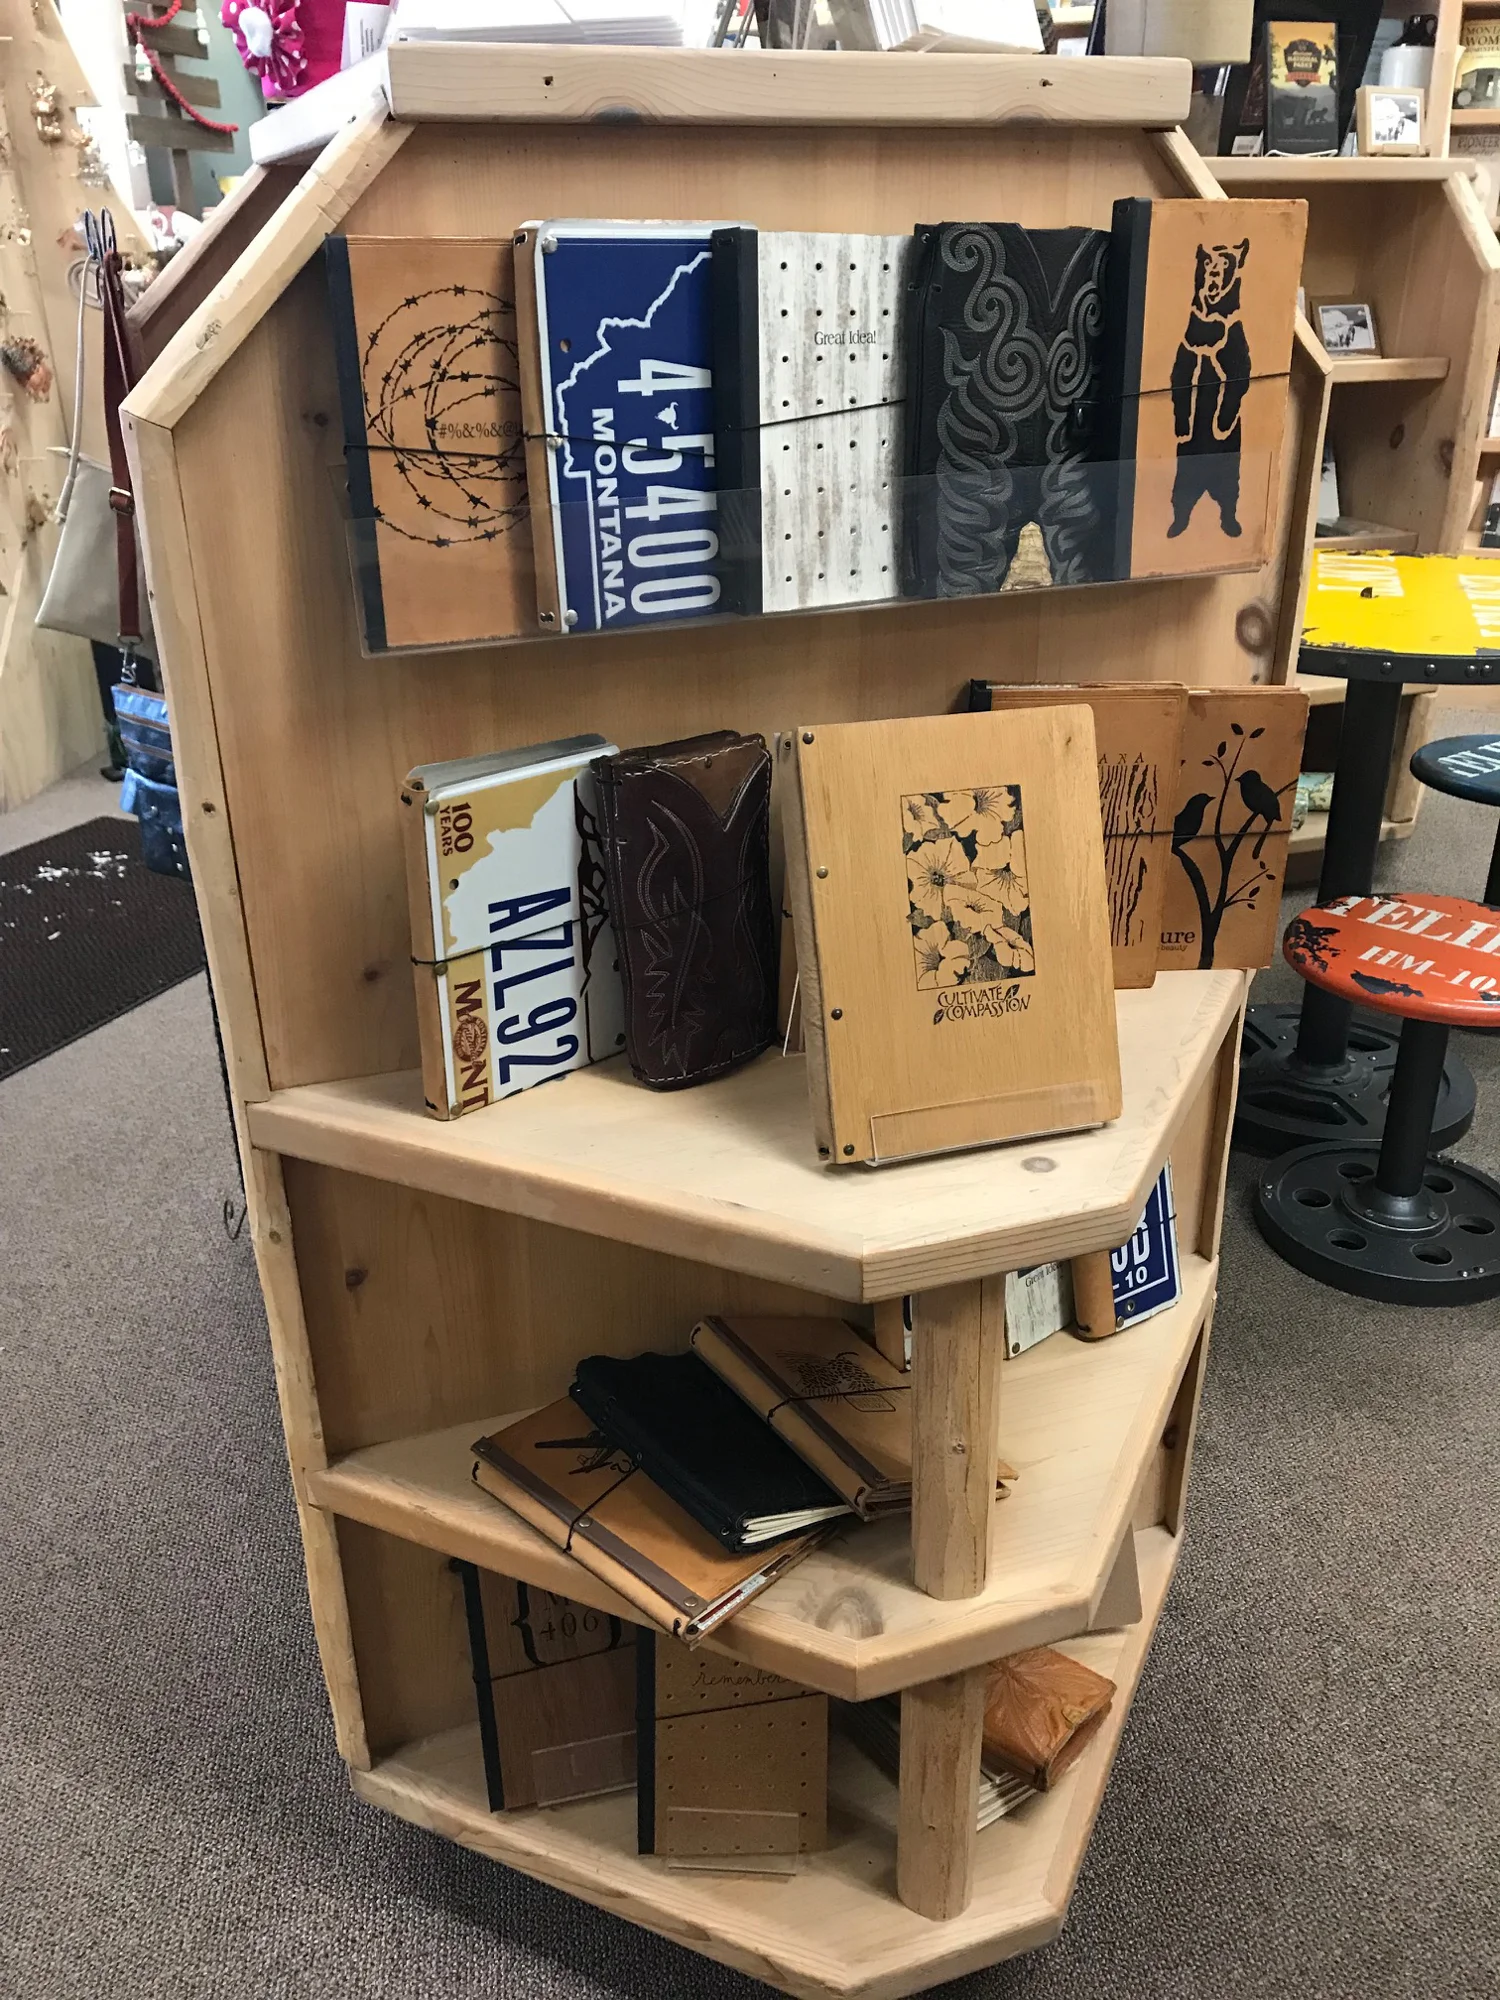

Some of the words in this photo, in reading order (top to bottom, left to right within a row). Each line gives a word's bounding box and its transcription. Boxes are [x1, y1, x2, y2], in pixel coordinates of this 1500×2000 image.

[814, 330, 846, 346] Great
[848, 329, 877, 345] Idea!
[617, 358, 713, 397] 4
[592, 407, 626, 620] MONTANA
[621, 433, 721, 614] 5400
[439, 804, 454, 857] YEARS
[451, 801, 475, 853] 100
[1160, 931, 1195, 944] ure
[488, 886, 580, 1100] AZL92
[938, 983, 1004, 1007] CULTIVATE
[946, 994, 1031, 1021] COMPASSION
